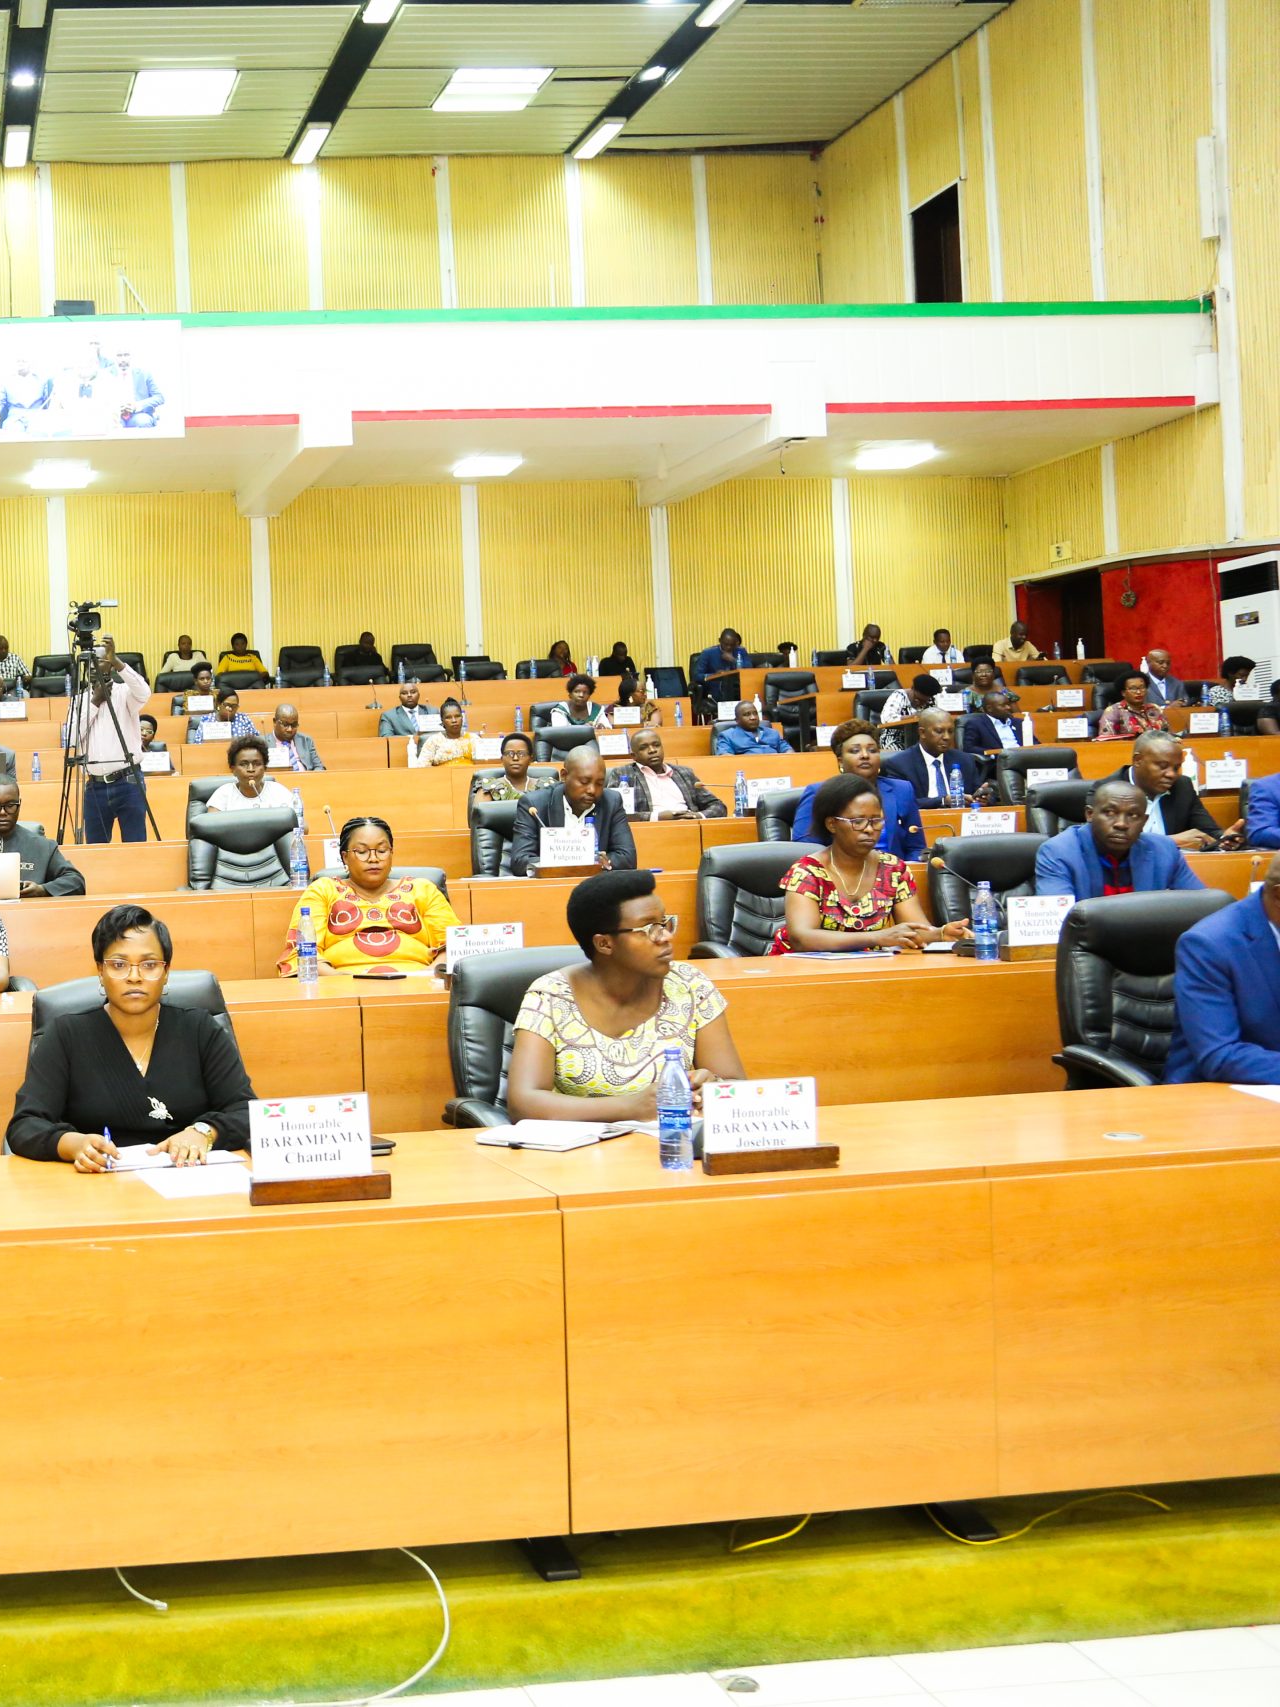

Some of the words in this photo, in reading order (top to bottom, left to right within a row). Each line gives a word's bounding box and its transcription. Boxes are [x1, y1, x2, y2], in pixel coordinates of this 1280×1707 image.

[1024, 910, 1060, 918] Honorable
[1014, 919, 1064, 927] HAKIZIMAN
[465, 939, 504, 947] Honorable
[731, 1106, 791, 1119] Honorable
[281, 1119, 342, 1131] Honorable
[711, 1119, 811, 1135] BARANYANKA
[260, 1132, 363, 1149] BARAMPAMA
[284, 1149, 342, 1165] Chantal
